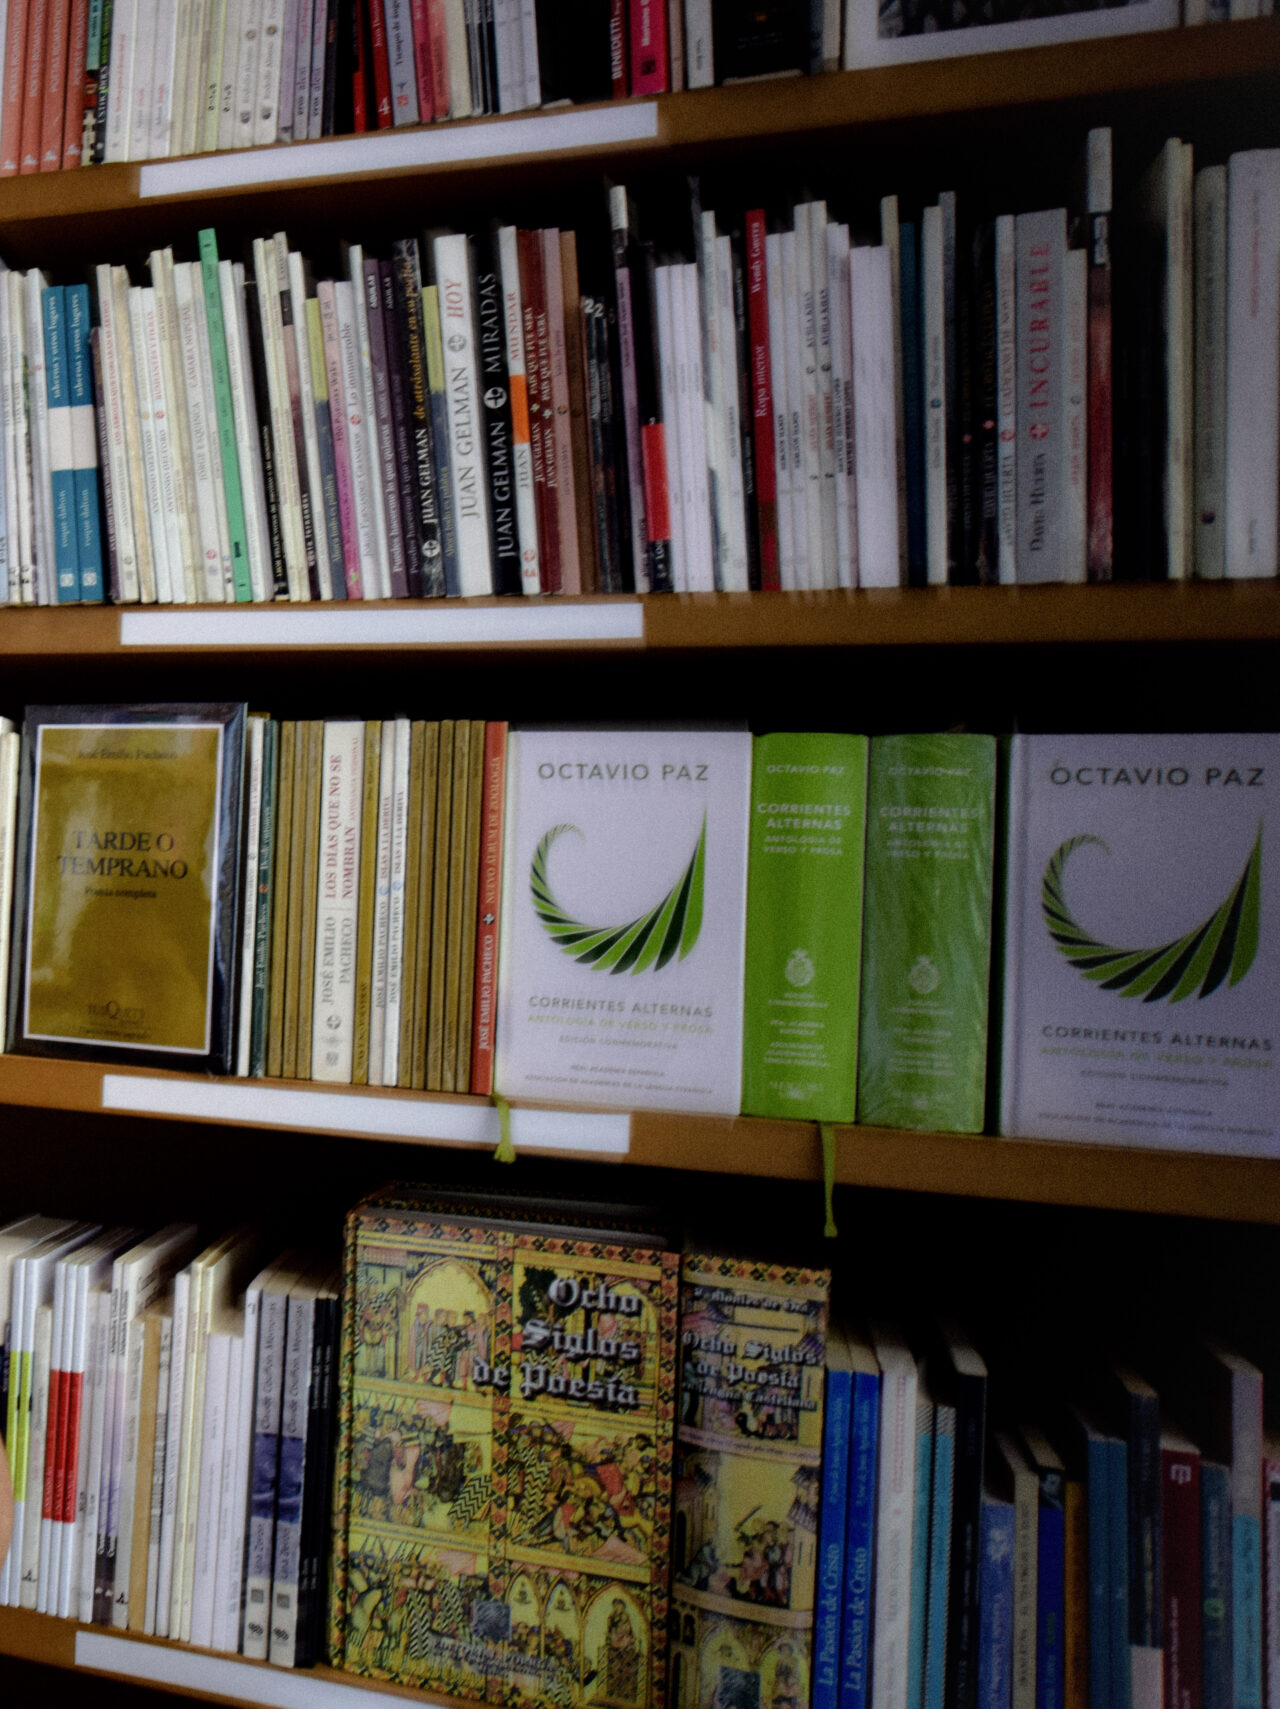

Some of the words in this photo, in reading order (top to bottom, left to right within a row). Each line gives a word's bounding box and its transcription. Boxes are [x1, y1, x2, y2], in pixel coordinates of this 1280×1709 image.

[610, 17, 622, 80] BENEDETTI
[748, 222, 760, 256] Guerra
[750, 258, 762, 293] Wendy
[47, 296, 59, 330] lugares
[69, 294, 80, 327] lugares
[406, 300, 417, 313] su
[444, 278, 464, 319] HOY
[181, 306, 193, 346] NUPCIAL
[407, 316, 418, 330] en
[479, 272, 502, 373] MIRADAS
[506, 291, 518, 360] MUNDAR
[1029, 242, 1049, 408] INCURABLE
[340, 323, 356, 389] innumerable
[753, 345, 766, 385] interior
[50, 362, 62, 398] taberna
[72, 360, 83, 396] taberna
[347, 392, 357, 406] Lo
[414, 404, 426, 419] de
[451, 367, 474, 456] GELMAN
[754, 387, 769, 417] Ropa
[191, 402, 206, 449] ESQUINCA
[381, 423, 393, 461] quieras
[530, 422, 542, 460] GELMAN
[416, 428, 432, 485] GELMAN
[490, 421, 511, 501] GELMAN
[542, 428, 553, 467] GELMAN
[196, 453, 207, 480] JORGE
[385, 463, 395, 481] que
[400, 464, 410, 481] que
[516, 449, 529, 488] JUAN
[533, 462, 544, 482] JUAN
[545, 468, 557, 488] JUAN
[1029, 453, 1046, 505] HUERTA
[80, 488, 89, 519] dalton
[325, 474, 338, 505] palabra
[385, 482, 394, 492] lo
[401, 484, 411, 493] lo
[457, 465, 479, 518] JUAN
[58, 489, 67, 520] dalton
[420, 488, 438, 524] JUAN
[59, 522, 70, 547] roque
[82, 521, 92, 546] roque
[328, 518, 338, 536] todo
[497, 507, 516, 557] JUAN
[1029, 510, 1045, 552] DAVID
[329, 538, 342, 563] Ahora
[389, 537, 403, 573] Puedes
[329, 754, 342, 773] SE
[538, 762, 650, 782] OCTAVIO
[662, 763, 710, 782] PAZ
[766, 763, 819, 775] OCTAVIO
[822, 765, 845, 775] PAZ
[1051, 766, 1189, 787] OCTAVIO
[1205, 767, 1265, 787] PAZ
[328, 775, 341, 797] NO
[326, 801, 341, 831] QUE
[381, 797, 392, 825] DERIVA
[395, 792, 405, 825] DERIVA
[488, 813, 498, 829] DE
[757, 803, 852, 817] CORRIENTES
[766, 818, 843, 831] ALTERNAS
[880, 805, 979, 819] CORRIENTES
[72, 830, 151, 851] TARDE
[156, 832, 175, 851] O
[382, 828, 391, 838] LA
[395, 827, 404, 838] LA
[888, 821, 968, 834] ALTERNAS
[323, 833, 339, 867] DÍAS
[341, 826, 356, 898] NOMBRAN
[380, 850, 390, 879] ISLAS
[394, 850, 404, 873] ISLAS
[56, 855, 189, 880] TEMPRANO
[324, 870, 338, 898] LOS
[485, 871, 496, 904] NUEVO
[378, 901, 388, 946] PACHECO
[391, 897, 402, 941] PACHECO
[322, 917, 336, 967] EMILIO
[339, 918, 353, 985] PACHECO
[482, 934, 494, 983] PACHECO
[376, 949, 387, 983] EMILIO
[390, 944, 401, 978] EMILIO
[320, 969, 335, 1004] JOSÉ
[375, 985, 385, 1008] JOSÉ
[389, 981, 400, 1004] JOSÉ
[480, 985, 492, 1023] EMILIO
[528, 995, 626, 1015] CORRIENTES
[632, 1001, 714, 1019] ALTERNAS
[478, 1025, 491, 1049] JOSÉ
[1042, 1024, 1162, 1045] CORRIENTES
[1170, 1032, 1273, 1052] ALTERNAS
[548, 1277, 642, 1316] Ocho
[522, 1318, 640, 1360] Siglos
[682, 1331, 737, 1356] Ocho
[743, 1340, 818, 1365] Siglos
[472, 1356, 509, 1384] de
[520, 1364, 638, 1406] Poesía
[696, 1360, 720, 1375] de
[726, 1363, 800, 1388] Poesía
[824, 1544, 840, 1591] Cristo
[851, 1547, 867, 1595] Cristo
[823, 1593, 837, 1613] de
[850, 1597, 864, 1618] de
[821, 1615, 838, 1662] Pasión
[847, 1620, 863, 1667] Pasión
[819, 1665, 834, 1686] La
[845, 1669, 861, 1690] La
